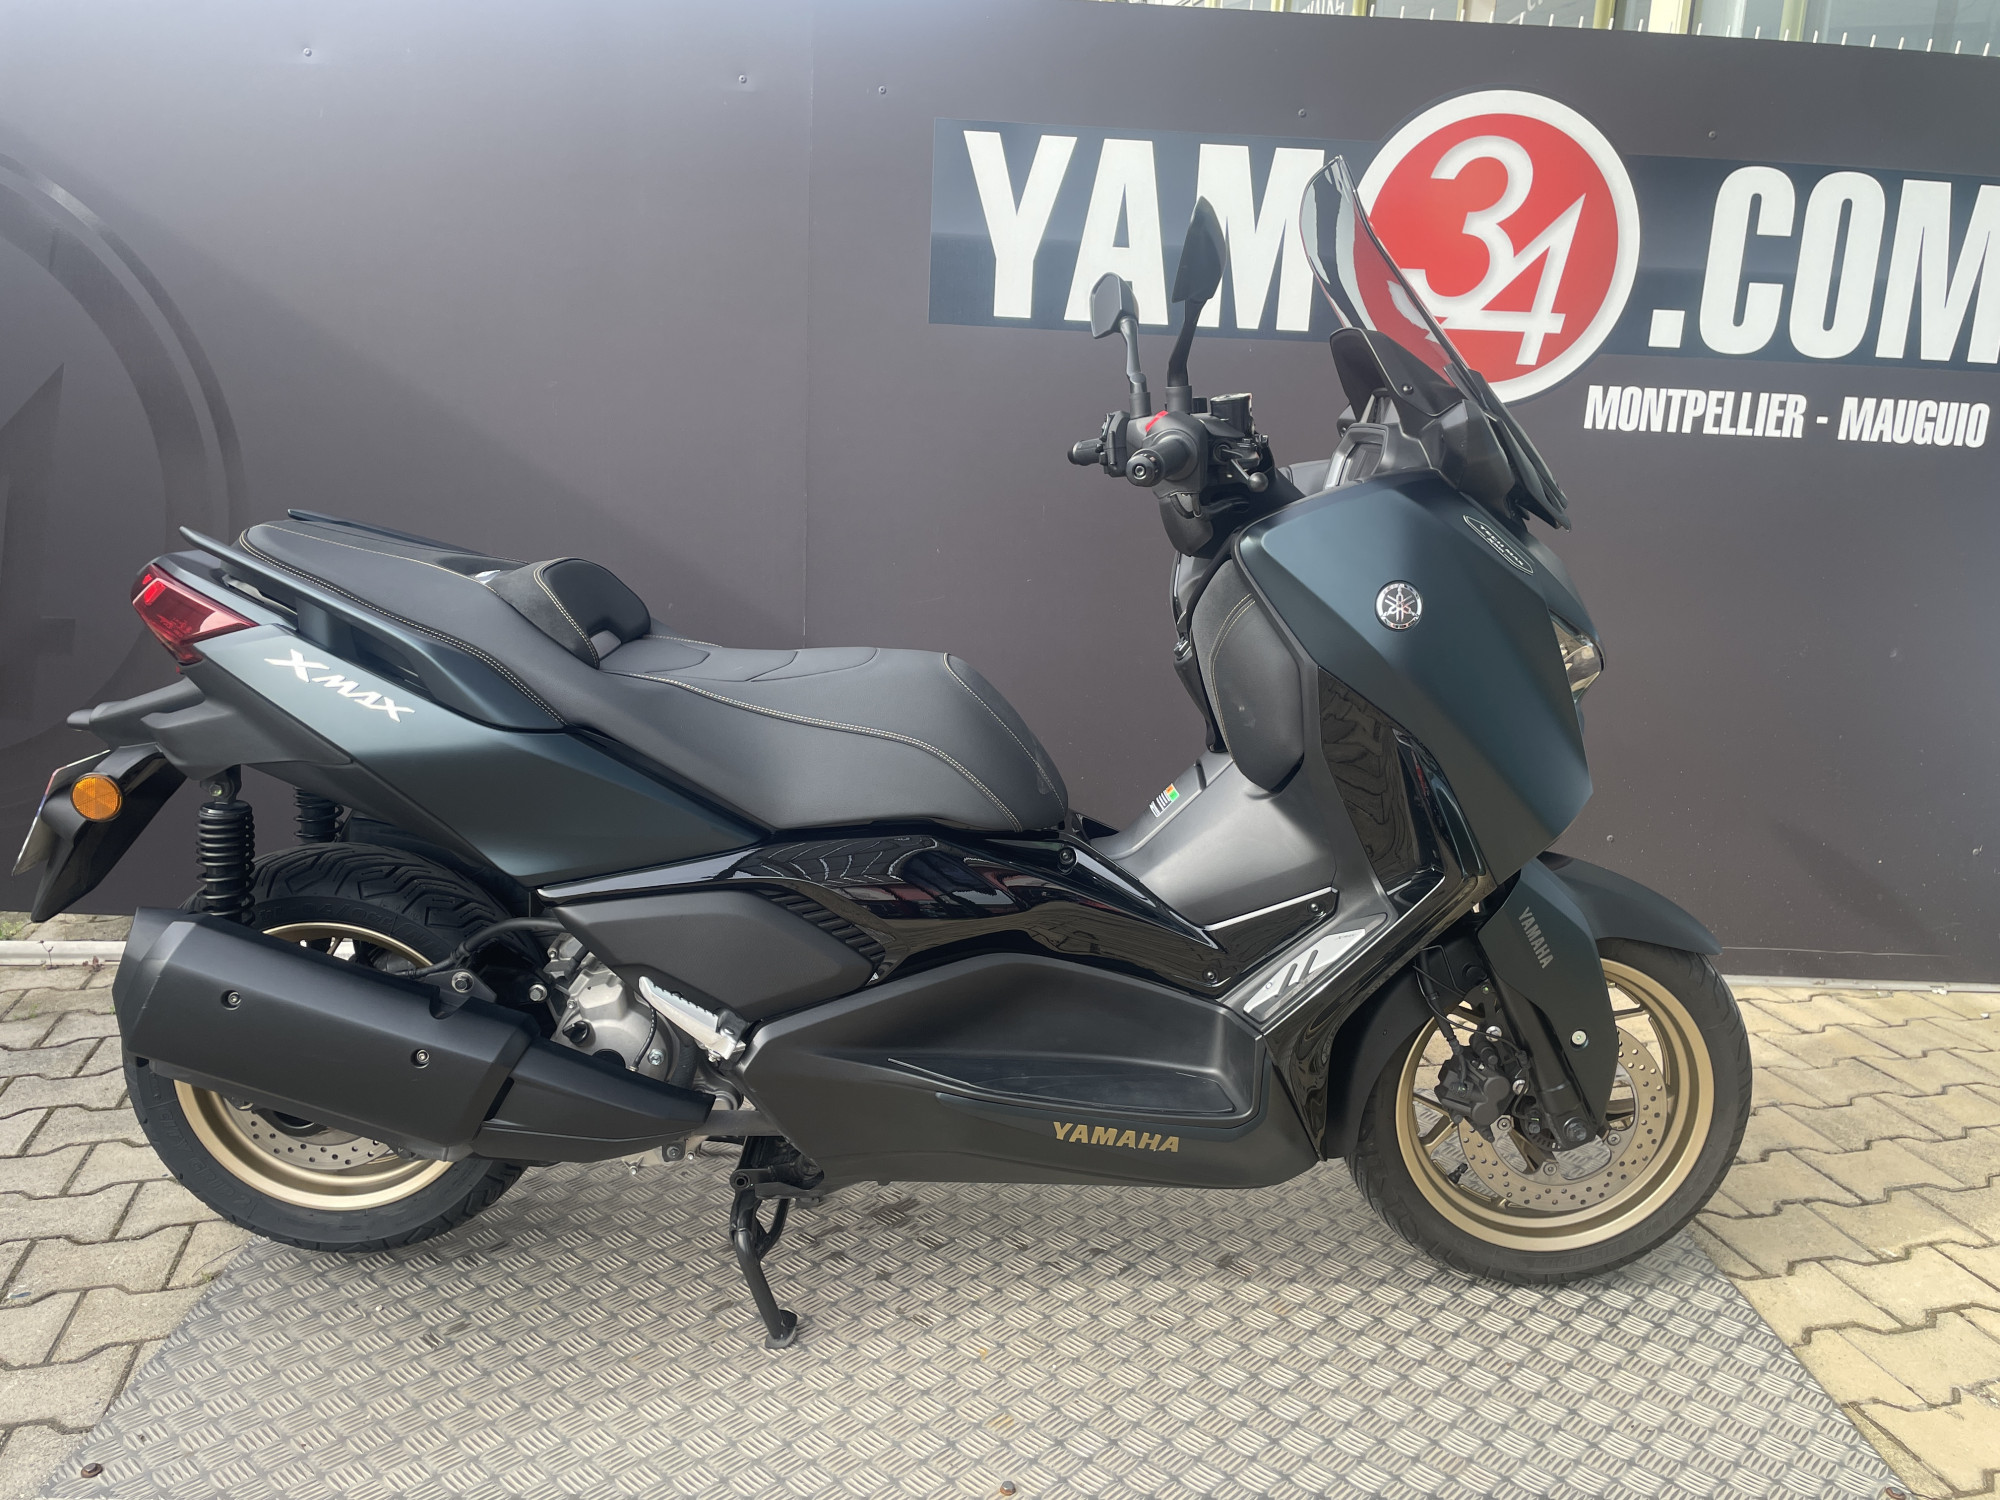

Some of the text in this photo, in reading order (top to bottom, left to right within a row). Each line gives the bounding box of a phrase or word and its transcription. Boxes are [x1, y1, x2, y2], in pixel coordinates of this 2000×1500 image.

[963, 130, 2000, 366] YAM 34 .COM
[1583, 384, 1808, 439] MONTPELLIER
[1837, 395, 1991, 448] MAUGUIO
[1518, 905, 1555, 970] YAMAHA
[1053, 1121, 1180, 1153] YAMAHA
